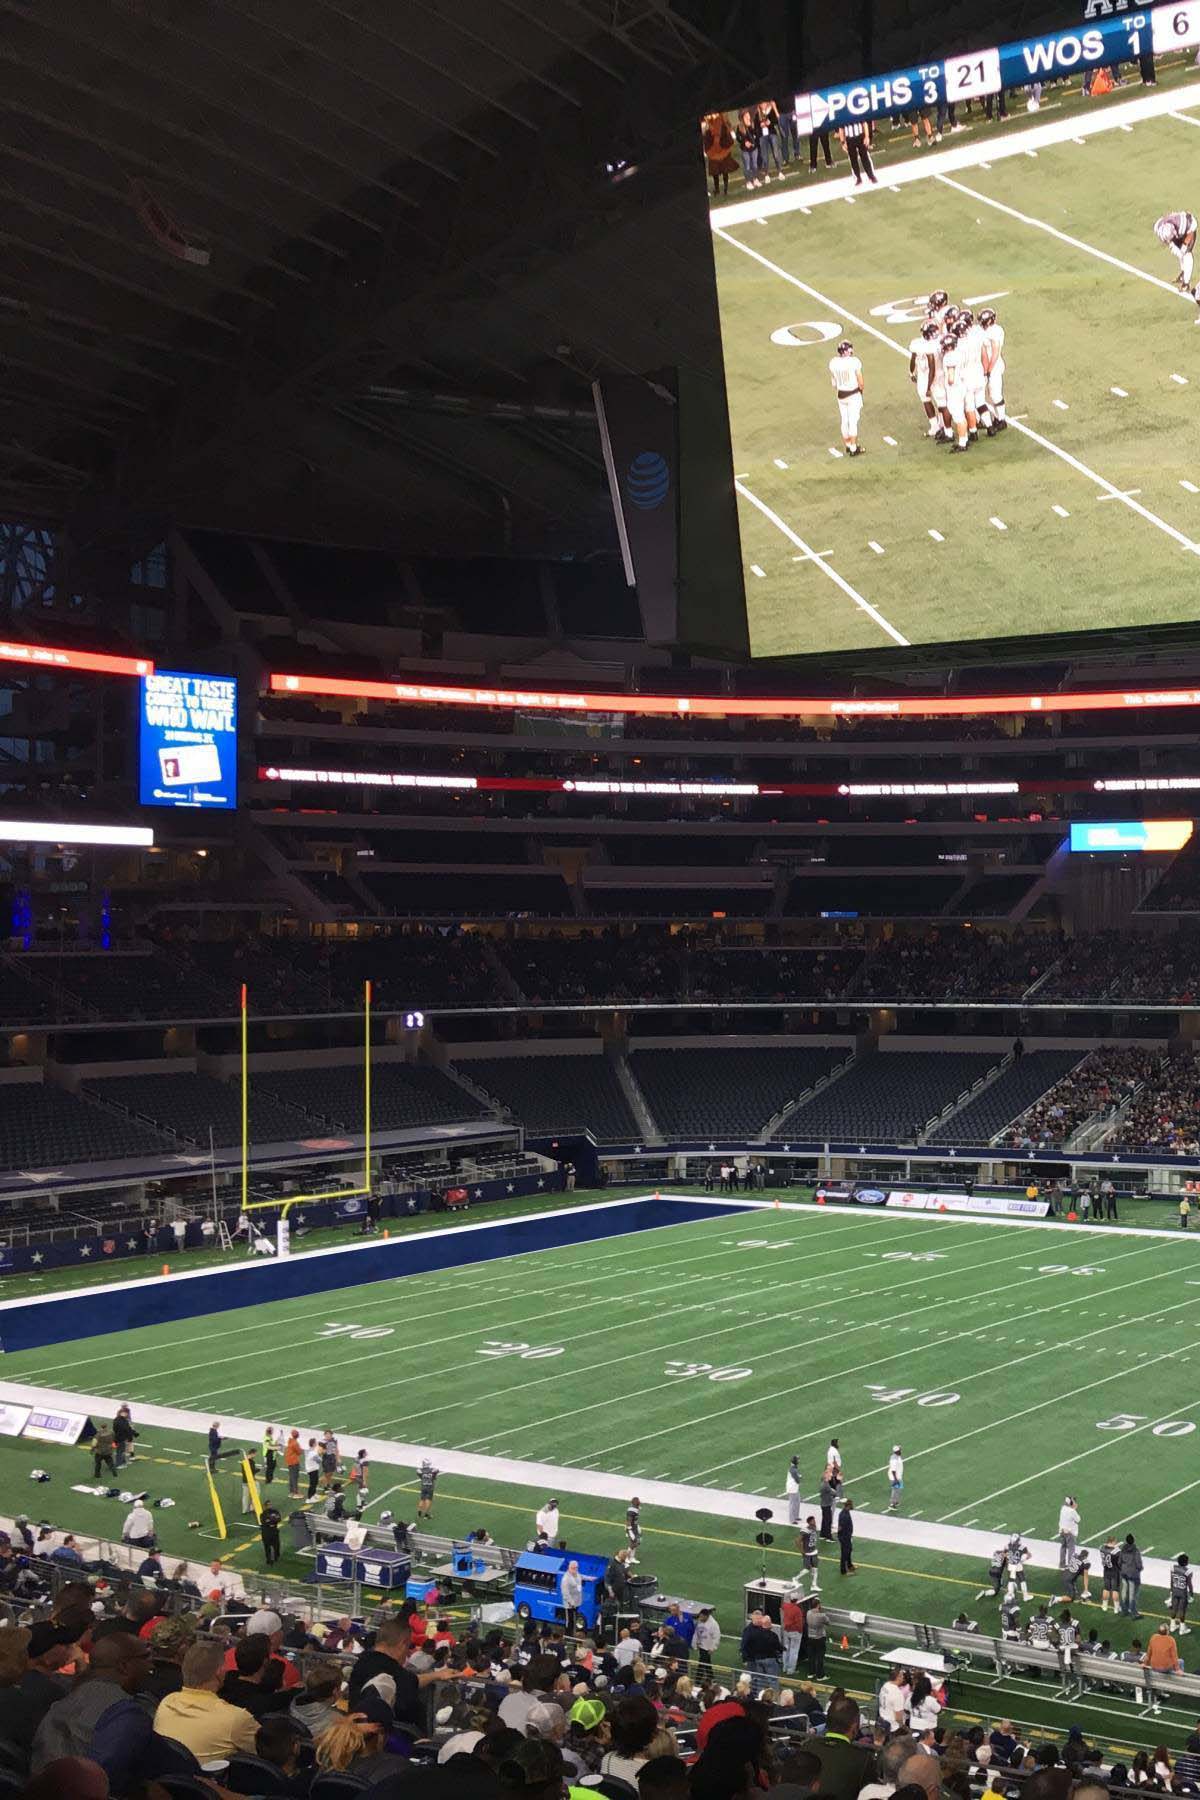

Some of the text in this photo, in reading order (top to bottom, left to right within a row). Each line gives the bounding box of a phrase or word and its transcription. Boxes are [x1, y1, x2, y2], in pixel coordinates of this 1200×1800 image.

[1122, 15, 1146, 31] TO
[1173, 12, 1189, 35] 6
[1022, 30, 1105, 74] WOS
[1128, 31, 1140, 55] 1
[919, 65, 940, 81] TO
[957, 61, 985, 88] 21
[828, 77, 912, 121] PGHS
[924, 81, 938, 104] 3
[145, 675, 235, 700] GREAT TASTE
[146, 705, 188, 728] WHO
[870, 1386, 961, 1408] 40
[1096, 1413, 1197, 1437] 50
